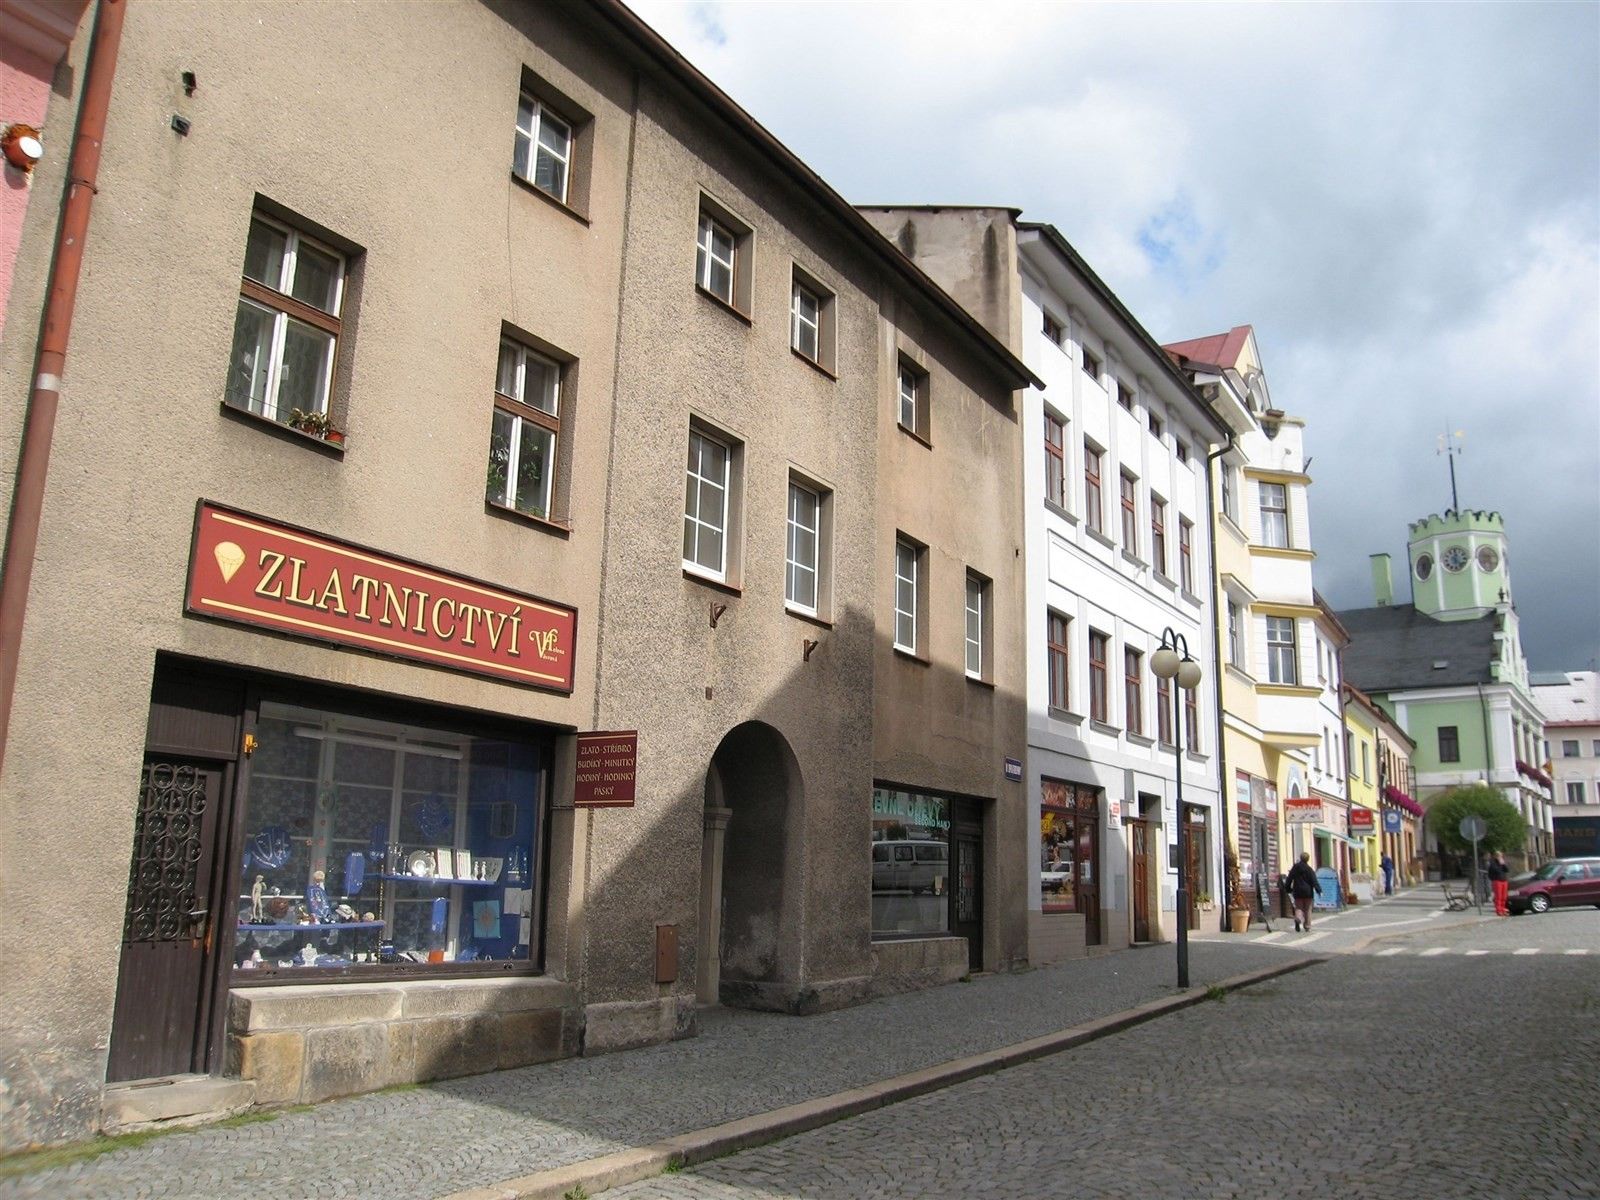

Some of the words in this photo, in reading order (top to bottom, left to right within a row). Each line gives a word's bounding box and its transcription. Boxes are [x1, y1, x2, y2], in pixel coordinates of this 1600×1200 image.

[254, 549, 522, 655] ZLATNICTVÍ
[580, 746, 600, 755] ZLATO
[604, 758, 635, 767] MINUTKY
[603, 771, 635, 781] HODINKY
